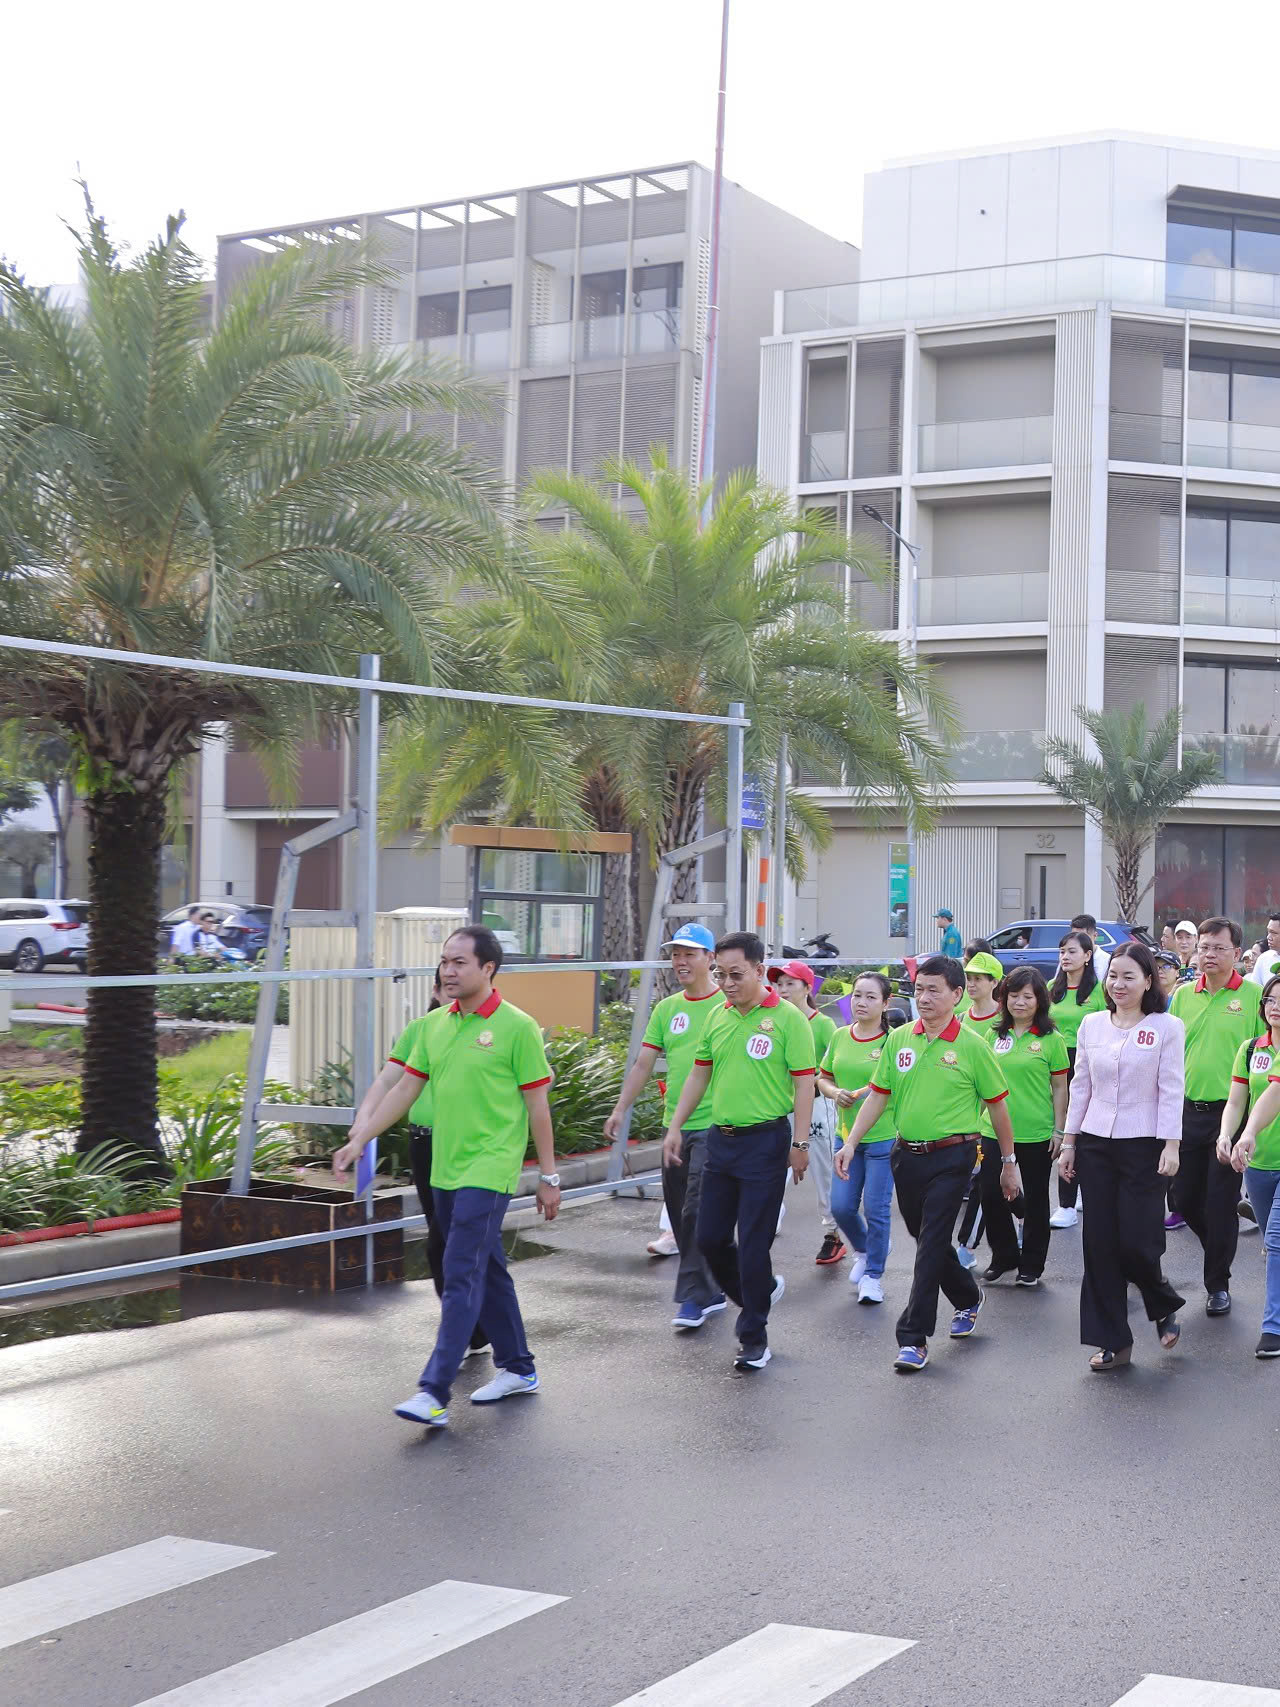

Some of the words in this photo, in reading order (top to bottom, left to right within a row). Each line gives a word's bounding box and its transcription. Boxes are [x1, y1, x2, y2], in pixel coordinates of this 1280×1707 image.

[1037, 834, 1055, 848] 32
[673, 1016, 685, 1031] 74
[996, 1038, 1011, 1049] 226
[1137, 1030, 1155, 1045] 86
[750, 1037, 769, 1055] 168
[898, 1052, 912, 1067] 85
[1253, 1056, 1270, 1069] 199
